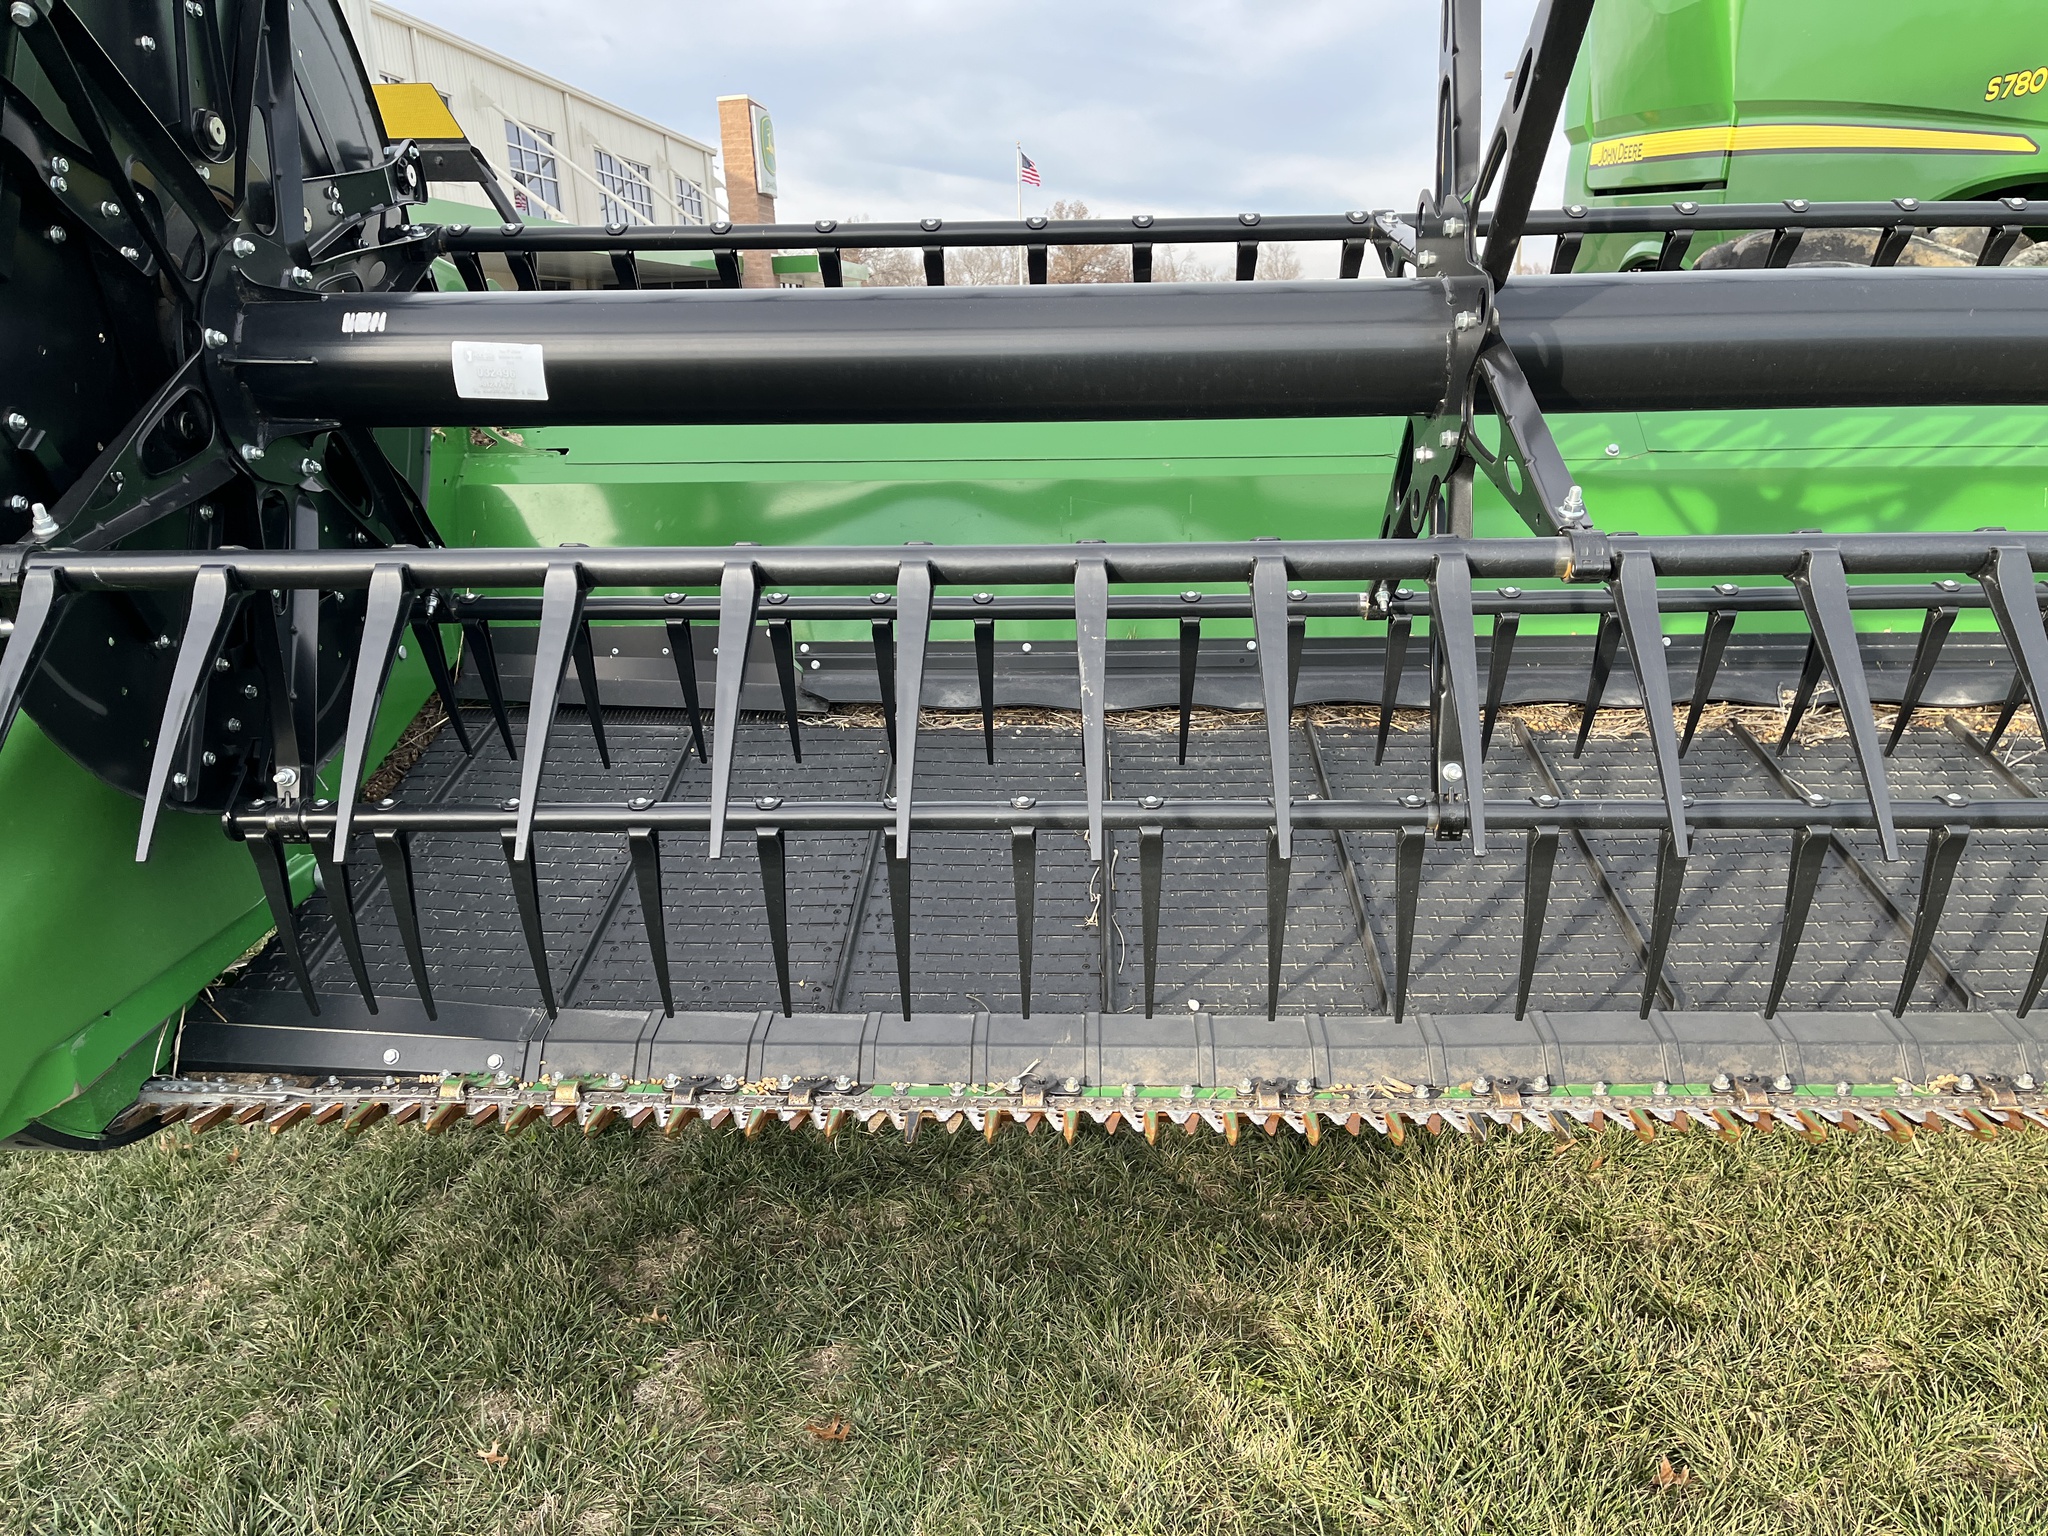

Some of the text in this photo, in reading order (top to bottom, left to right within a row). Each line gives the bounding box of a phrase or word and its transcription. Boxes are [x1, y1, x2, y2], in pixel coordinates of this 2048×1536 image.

[1984, 66, 2048, 102] S780
[1600, 142, 1644, 164] JOHN DEERE
